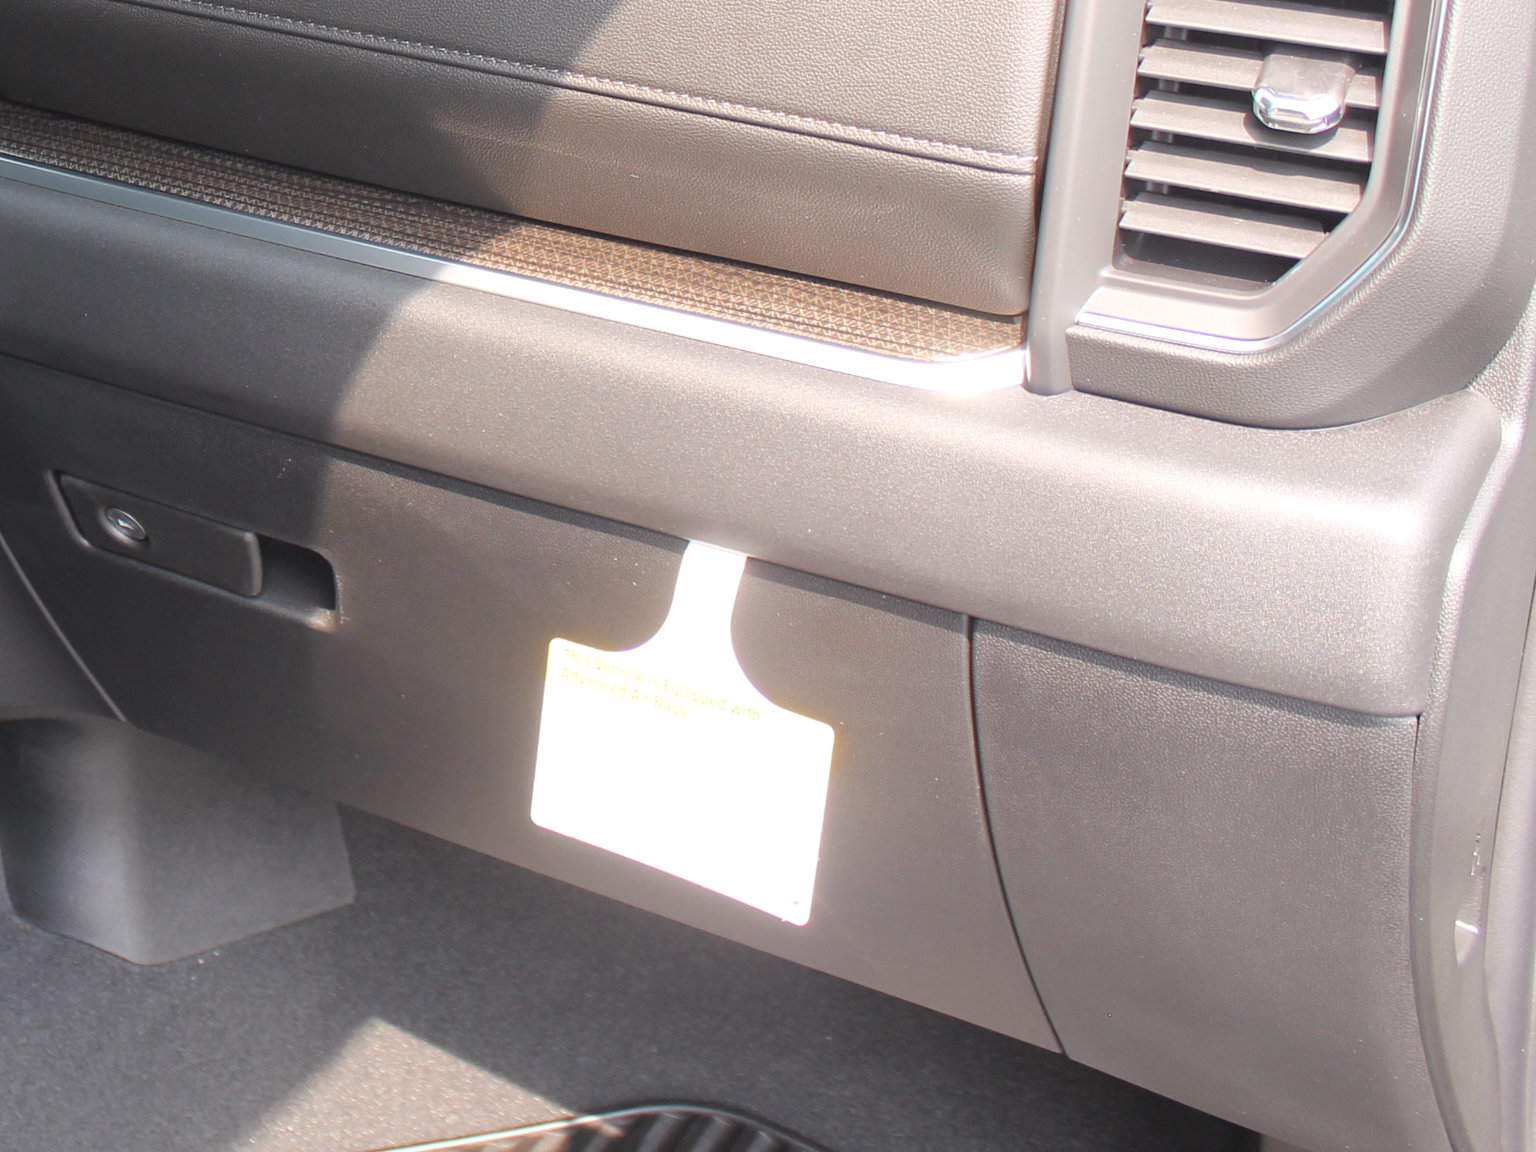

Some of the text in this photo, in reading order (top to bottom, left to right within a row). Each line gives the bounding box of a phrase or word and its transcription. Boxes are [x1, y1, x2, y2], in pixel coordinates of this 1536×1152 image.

[560, 666, 688, 719] Advanced Air Bags
[596, 658, 645, 683] Vehicle
[662, 679, 728, 712] Equipped
[730, 704, 761, 721] with
